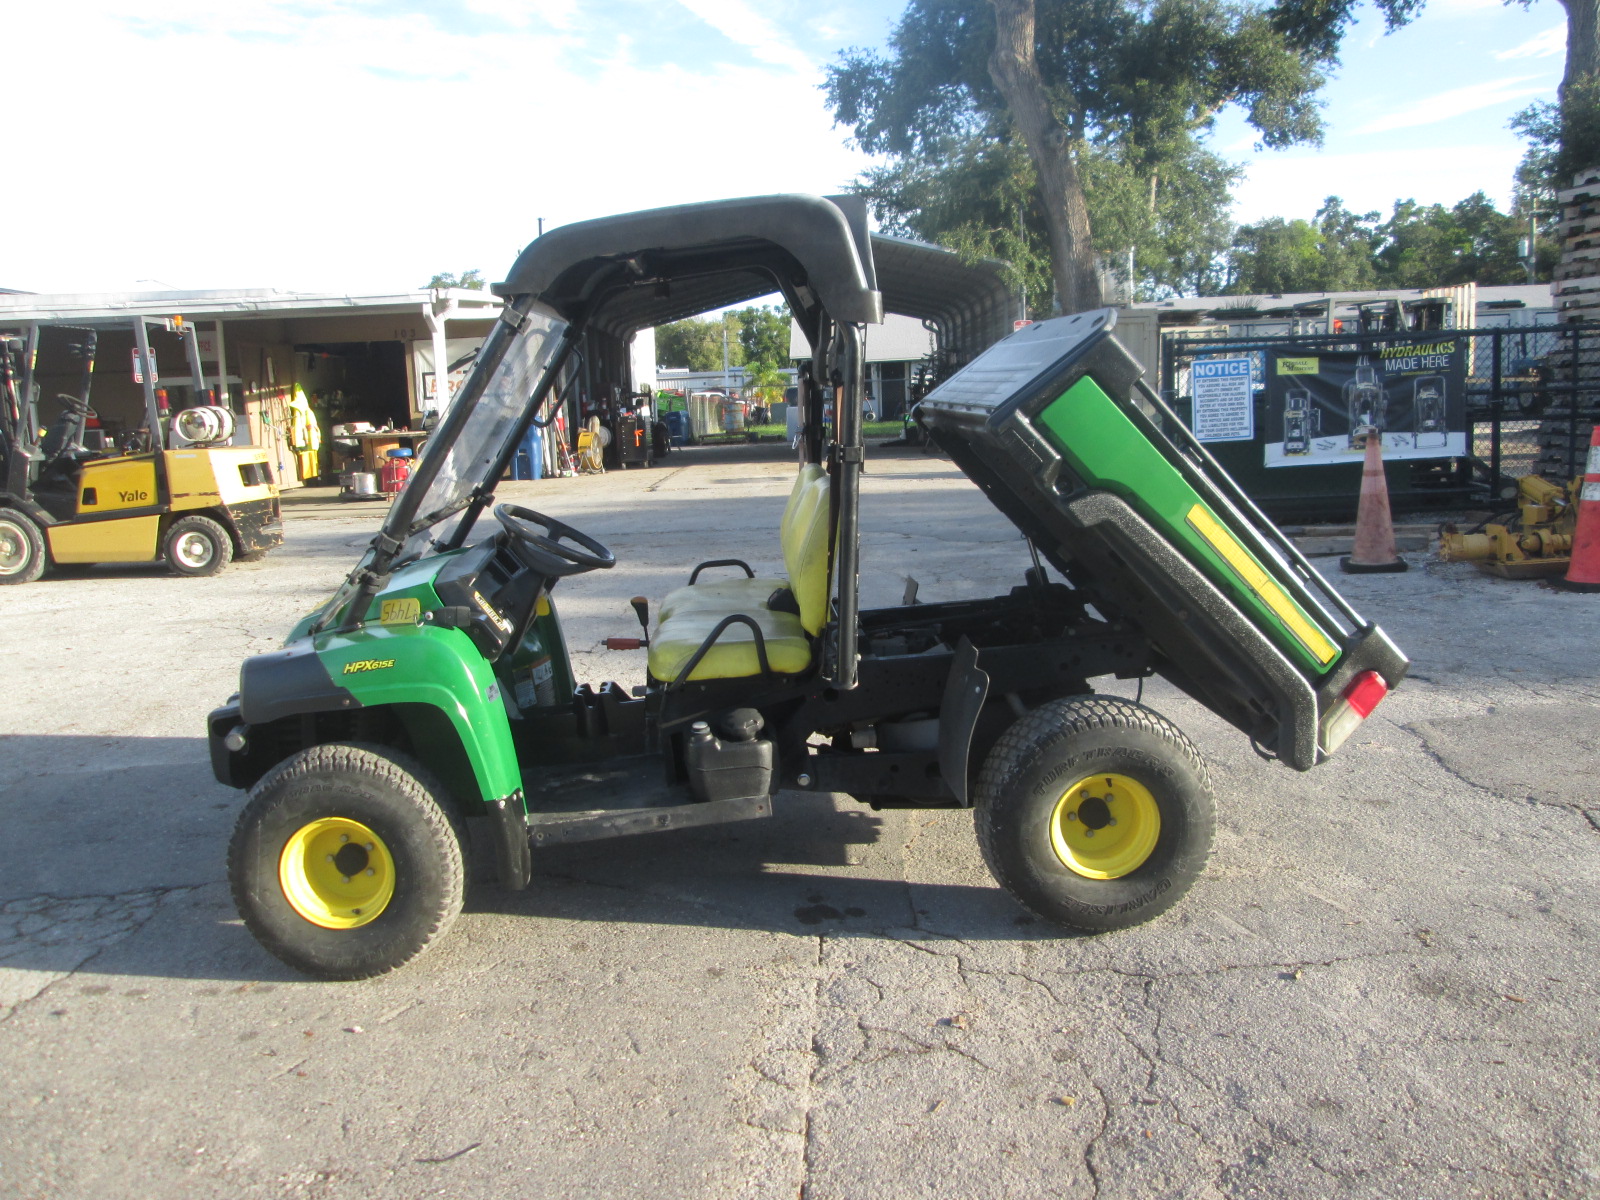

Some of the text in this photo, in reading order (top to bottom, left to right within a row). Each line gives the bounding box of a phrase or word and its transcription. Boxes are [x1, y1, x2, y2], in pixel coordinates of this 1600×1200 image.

[1380, 341, 1456, 358] HYDRAULICS
[1195, 362, 1248, 376] NOTICE
[1385, 354, 1450, 371] MADE HERE
[119, 490, 148, 502] Yale
[383, 602, 410, 622] 7495
[343, 659, 396, 674] HPX615E
[1082, 746, 1144, 760] TRAC
[1058, 877, 1172, 916] CARLISLE
